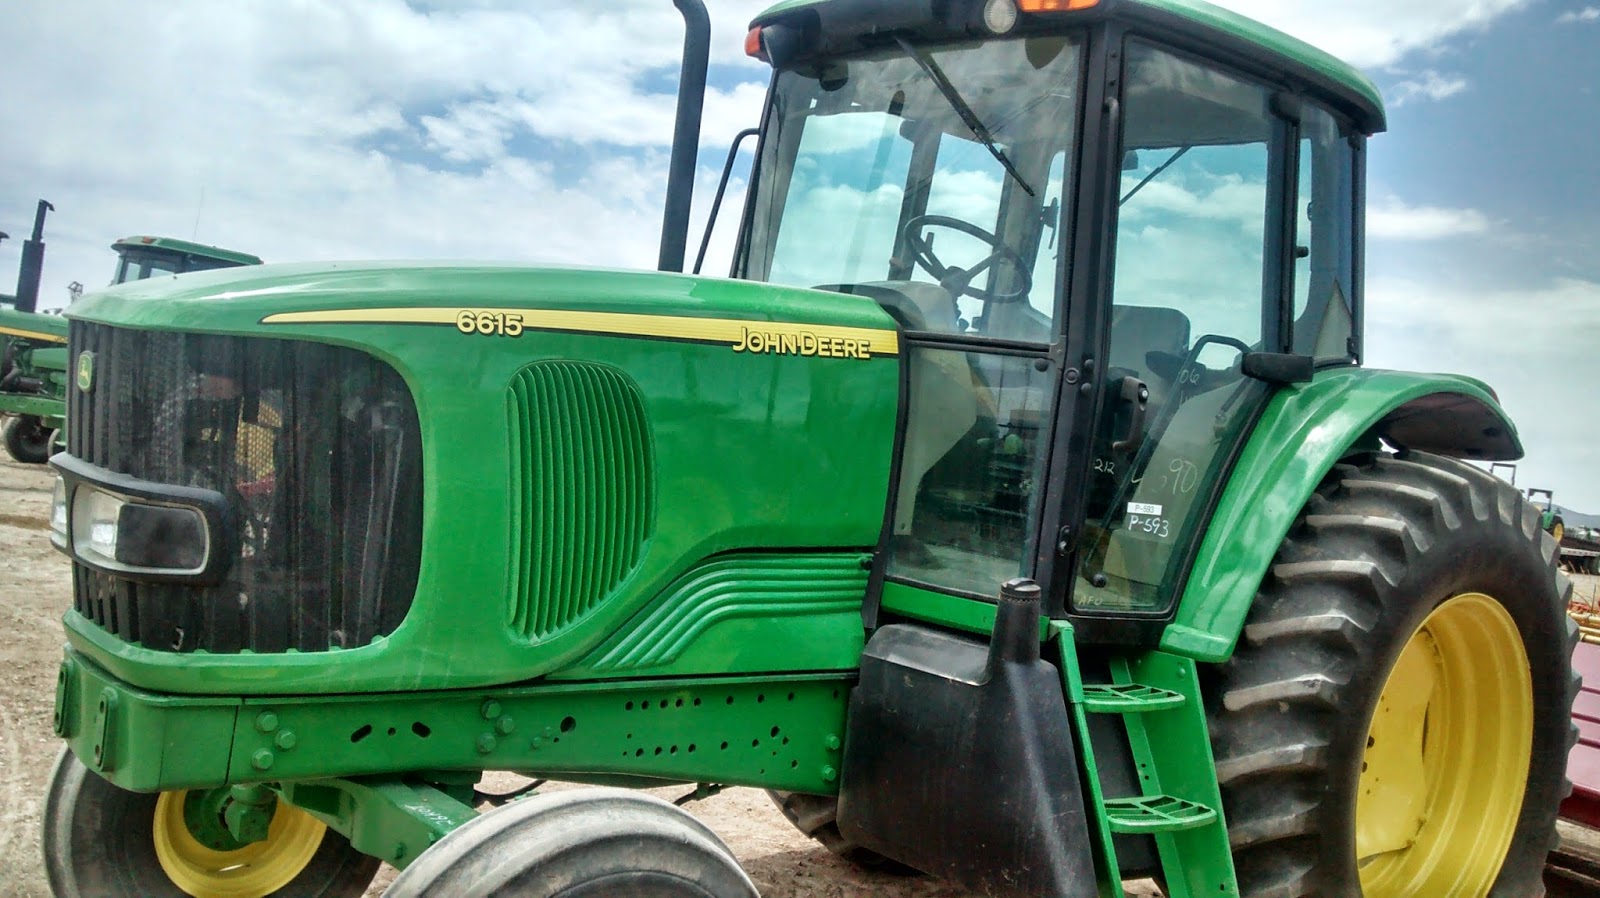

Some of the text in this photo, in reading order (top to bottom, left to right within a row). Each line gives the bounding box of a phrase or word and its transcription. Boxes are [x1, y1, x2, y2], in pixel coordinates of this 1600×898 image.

[456, 309, 524, 338] 6615
[732, 326, 871, 360] JOHN DEERE
[1134, 504, 1156, 514] P-593
[1128, 515, 1169, 538] P-593
